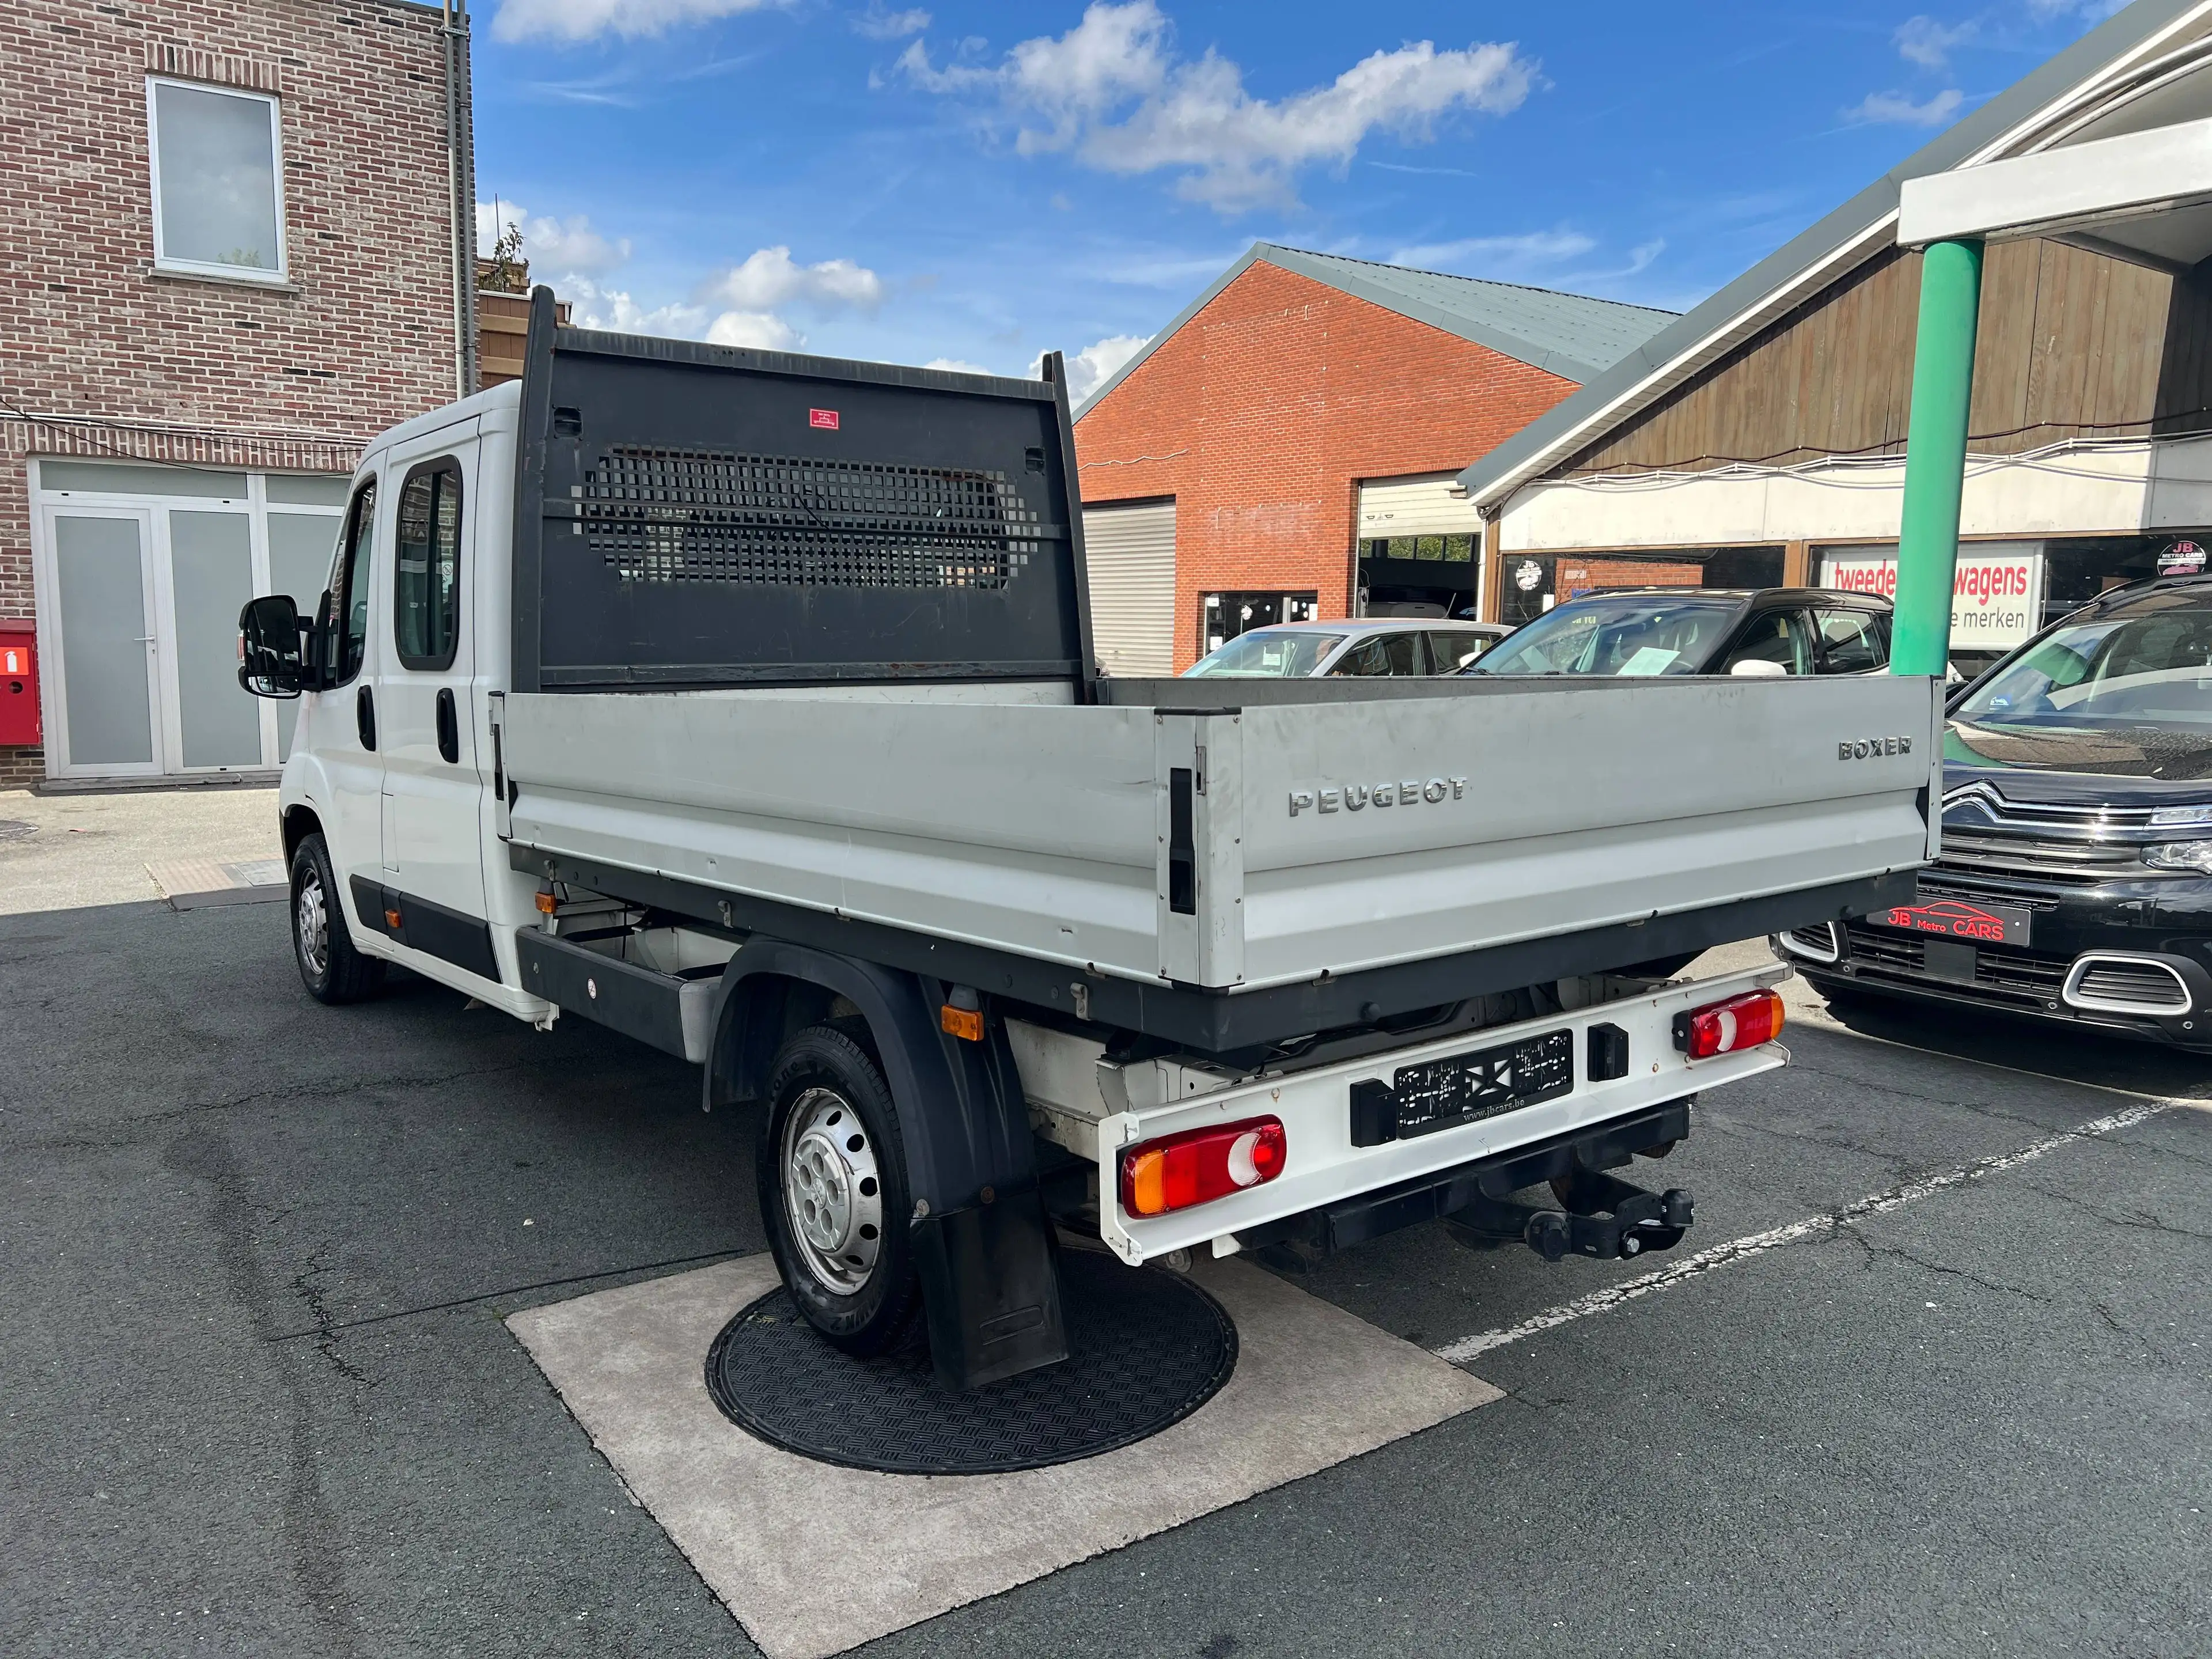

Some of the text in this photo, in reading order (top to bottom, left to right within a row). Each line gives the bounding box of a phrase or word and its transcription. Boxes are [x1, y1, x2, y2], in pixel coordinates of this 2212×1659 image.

[2172, 543, 2194, 553] JB
[1963, 607, 2024, 628] merken
[1838, 736, 1912, 760] BOXER
[1289, 775, 1468, 817] PEUGEOT
[1888, 911, 2004, 941] JB Metro CARS
[1463, 1099, 1525, 1122] www.jbcars.be
